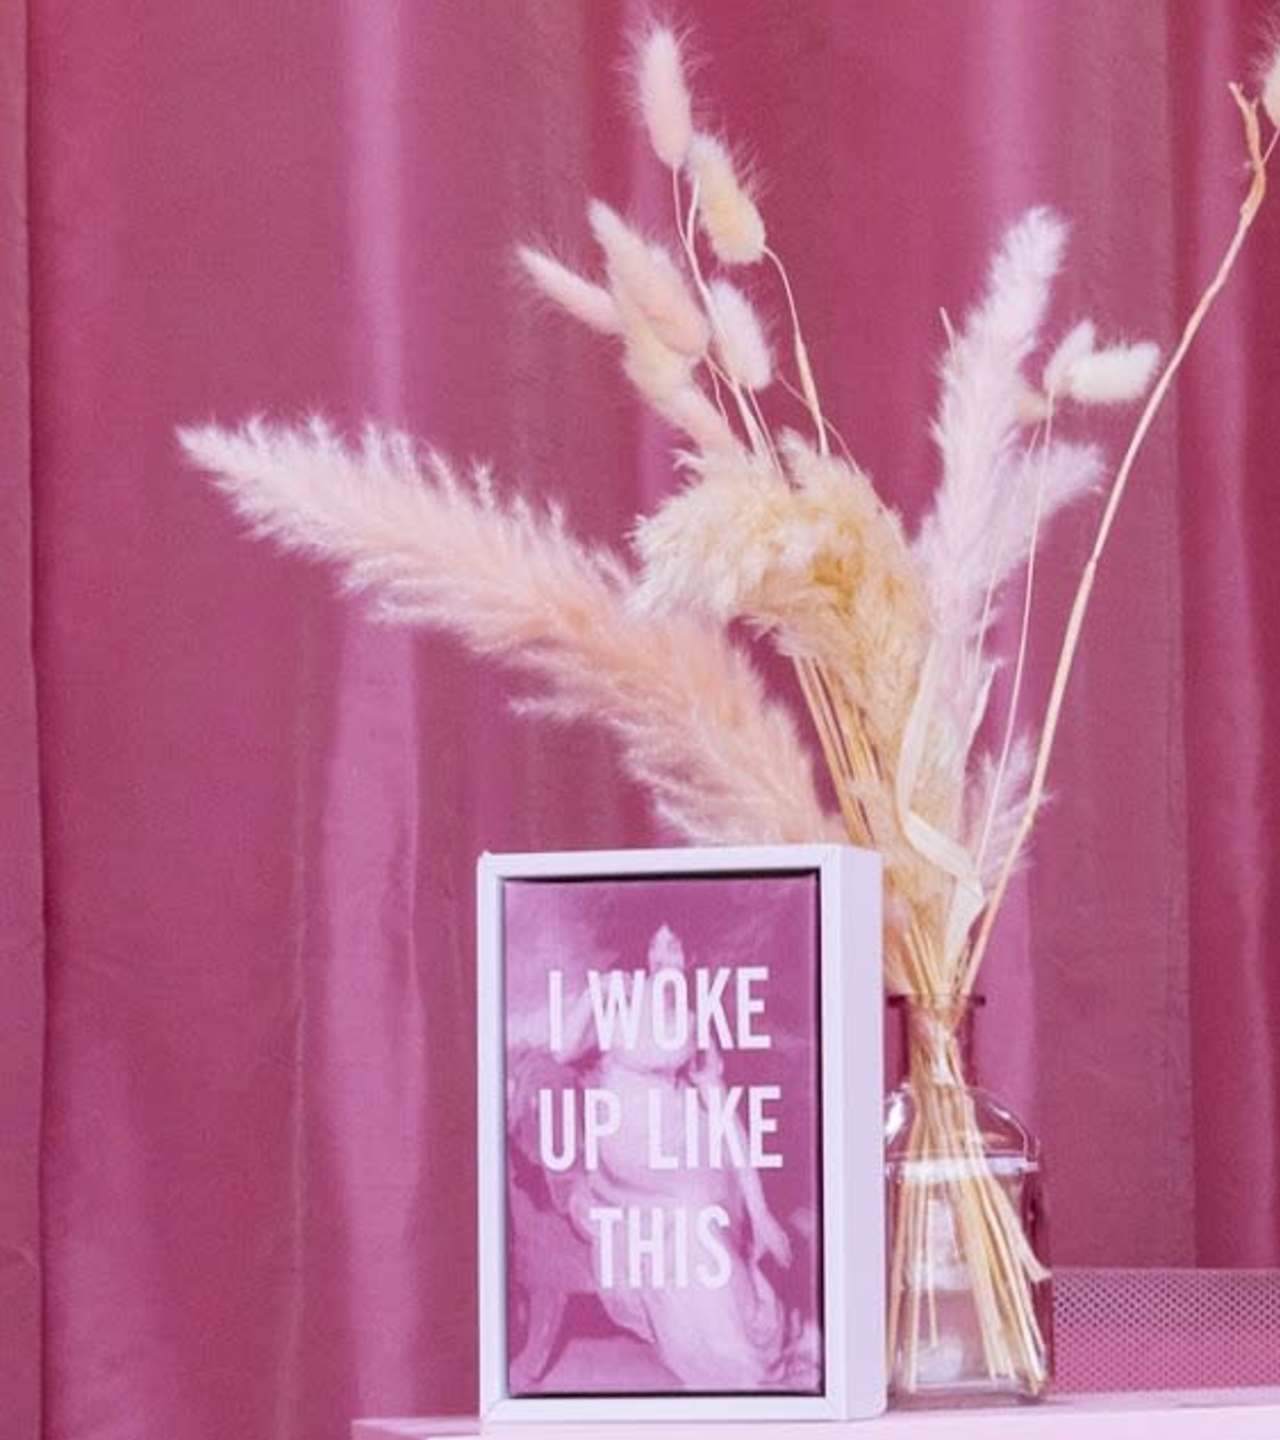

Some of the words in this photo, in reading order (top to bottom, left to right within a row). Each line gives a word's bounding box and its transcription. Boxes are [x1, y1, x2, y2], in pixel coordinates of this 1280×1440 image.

[547, 969, 564, 1052] I
[588, 966, 772, 1051] WOKE
[537, 1088, 622, 1172] UP
[647, 1085, 784, 1171] LIKE
[588, 1204, 733, 1290] THIS
